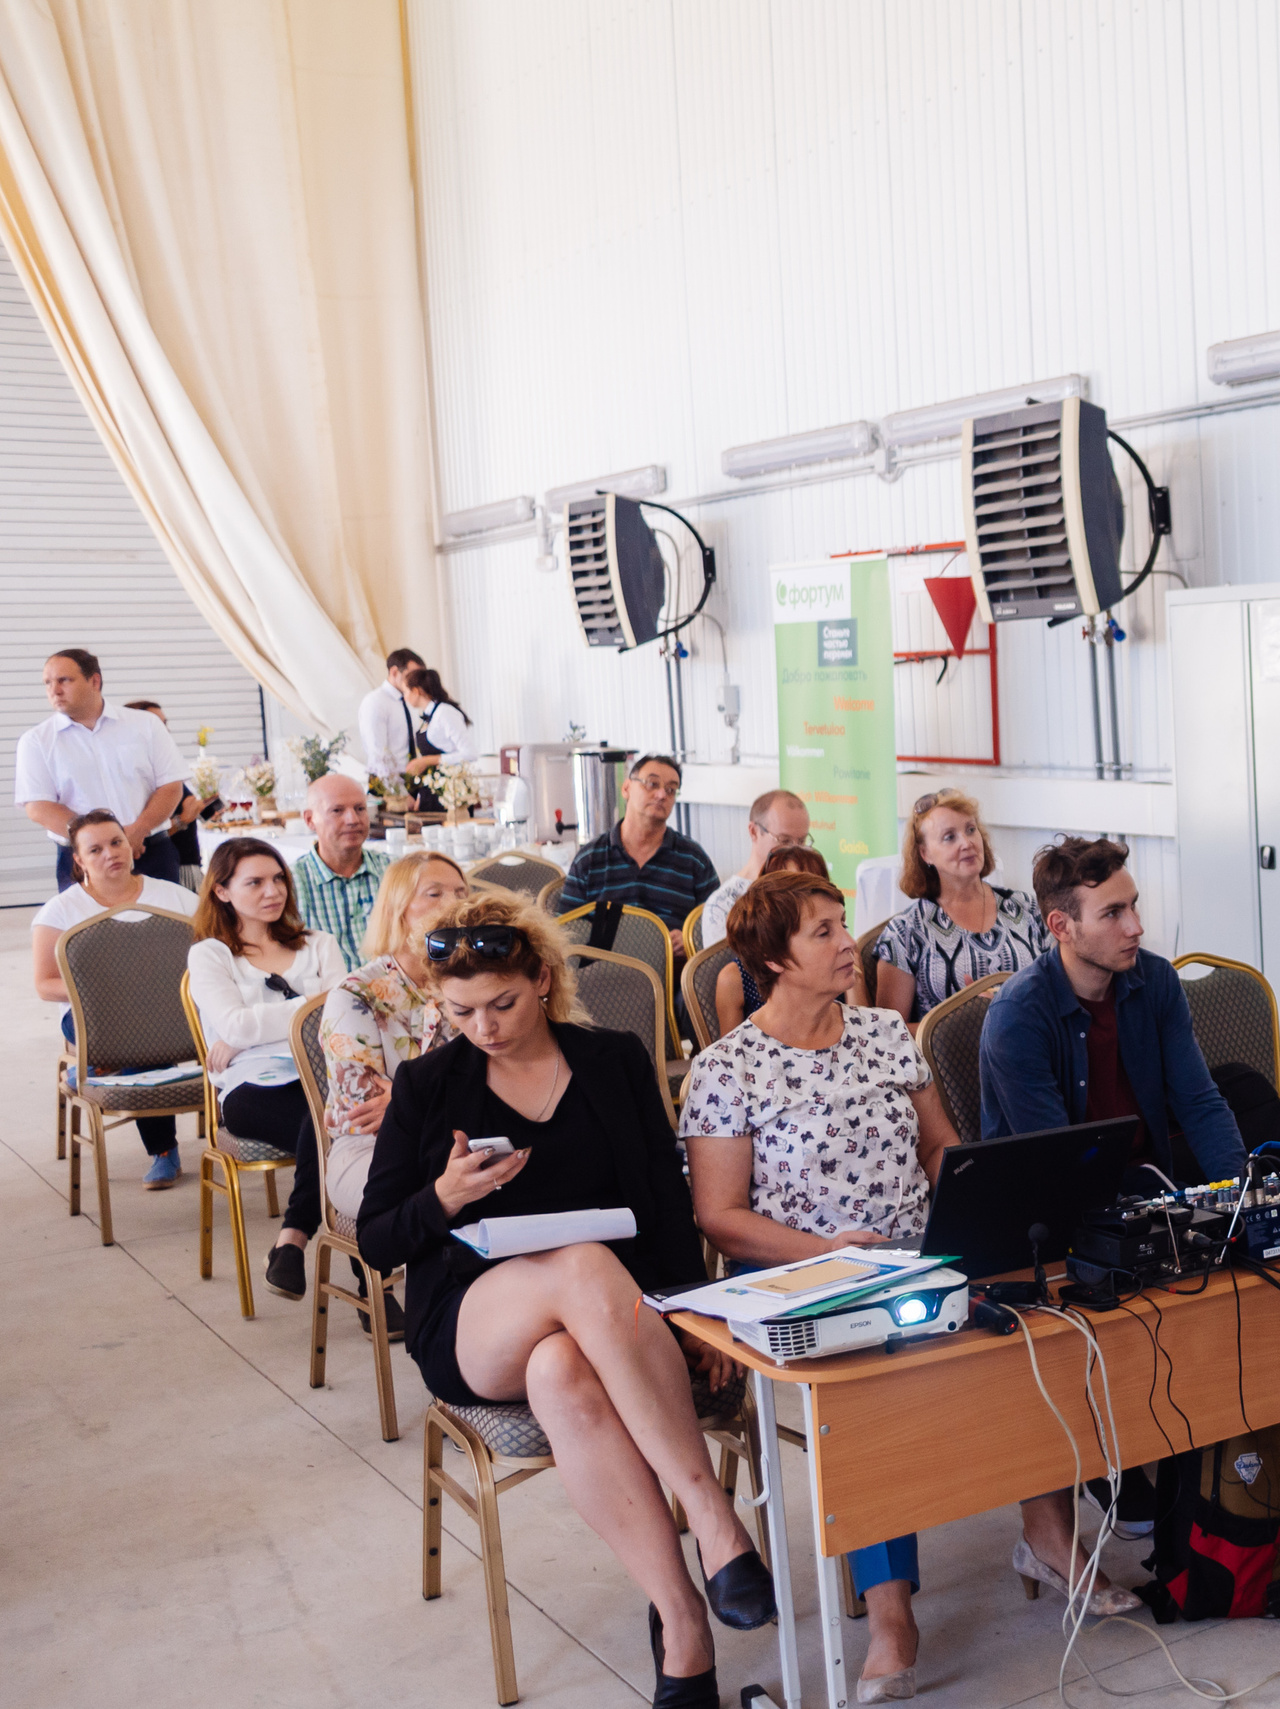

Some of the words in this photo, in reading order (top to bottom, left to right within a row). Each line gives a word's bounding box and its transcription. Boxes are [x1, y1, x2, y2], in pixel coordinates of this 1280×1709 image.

[789, 584, 844, 610] фортум
[833, 696, 874, 711] Welcome
[850, 1320, 872, 1329] EPSON
